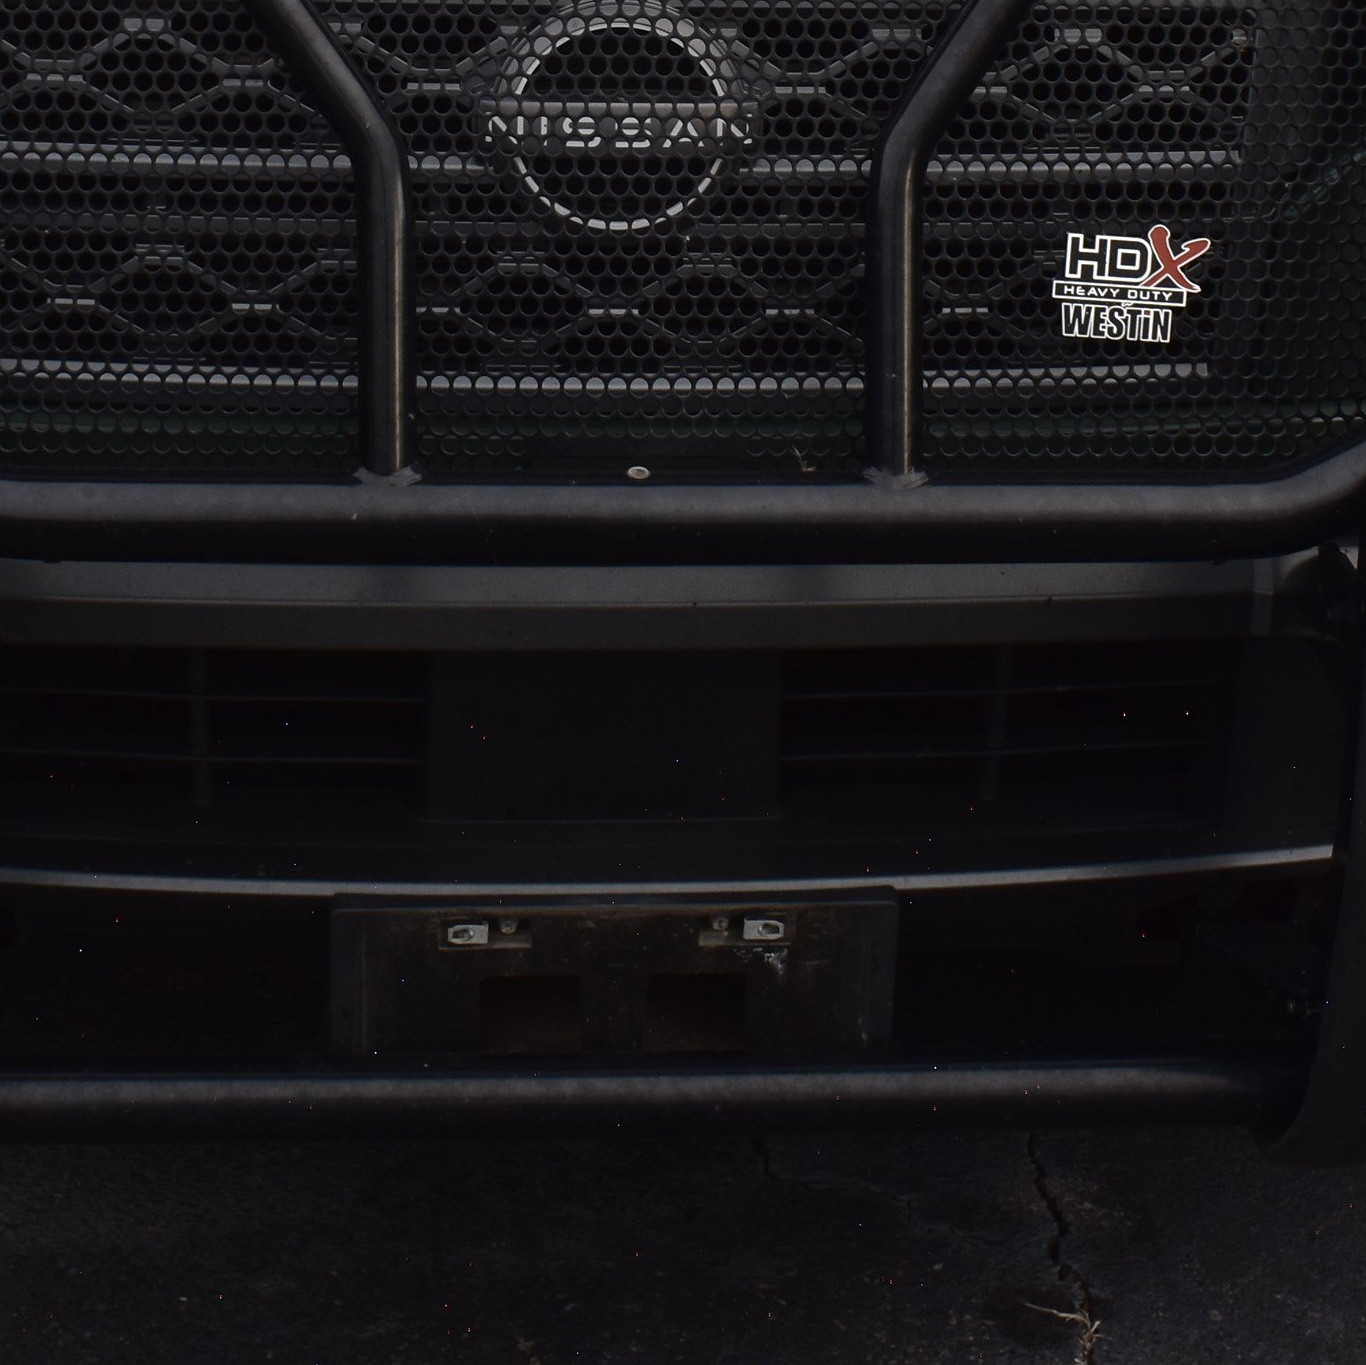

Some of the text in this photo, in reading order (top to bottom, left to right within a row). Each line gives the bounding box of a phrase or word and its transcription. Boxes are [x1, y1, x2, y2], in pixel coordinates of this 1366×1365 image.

[485, 115, 753, 148] NISSAN
[1064, 224, 1212, 293] HDX
[1063, 284, 1173, 302] HEAVY DUTY
